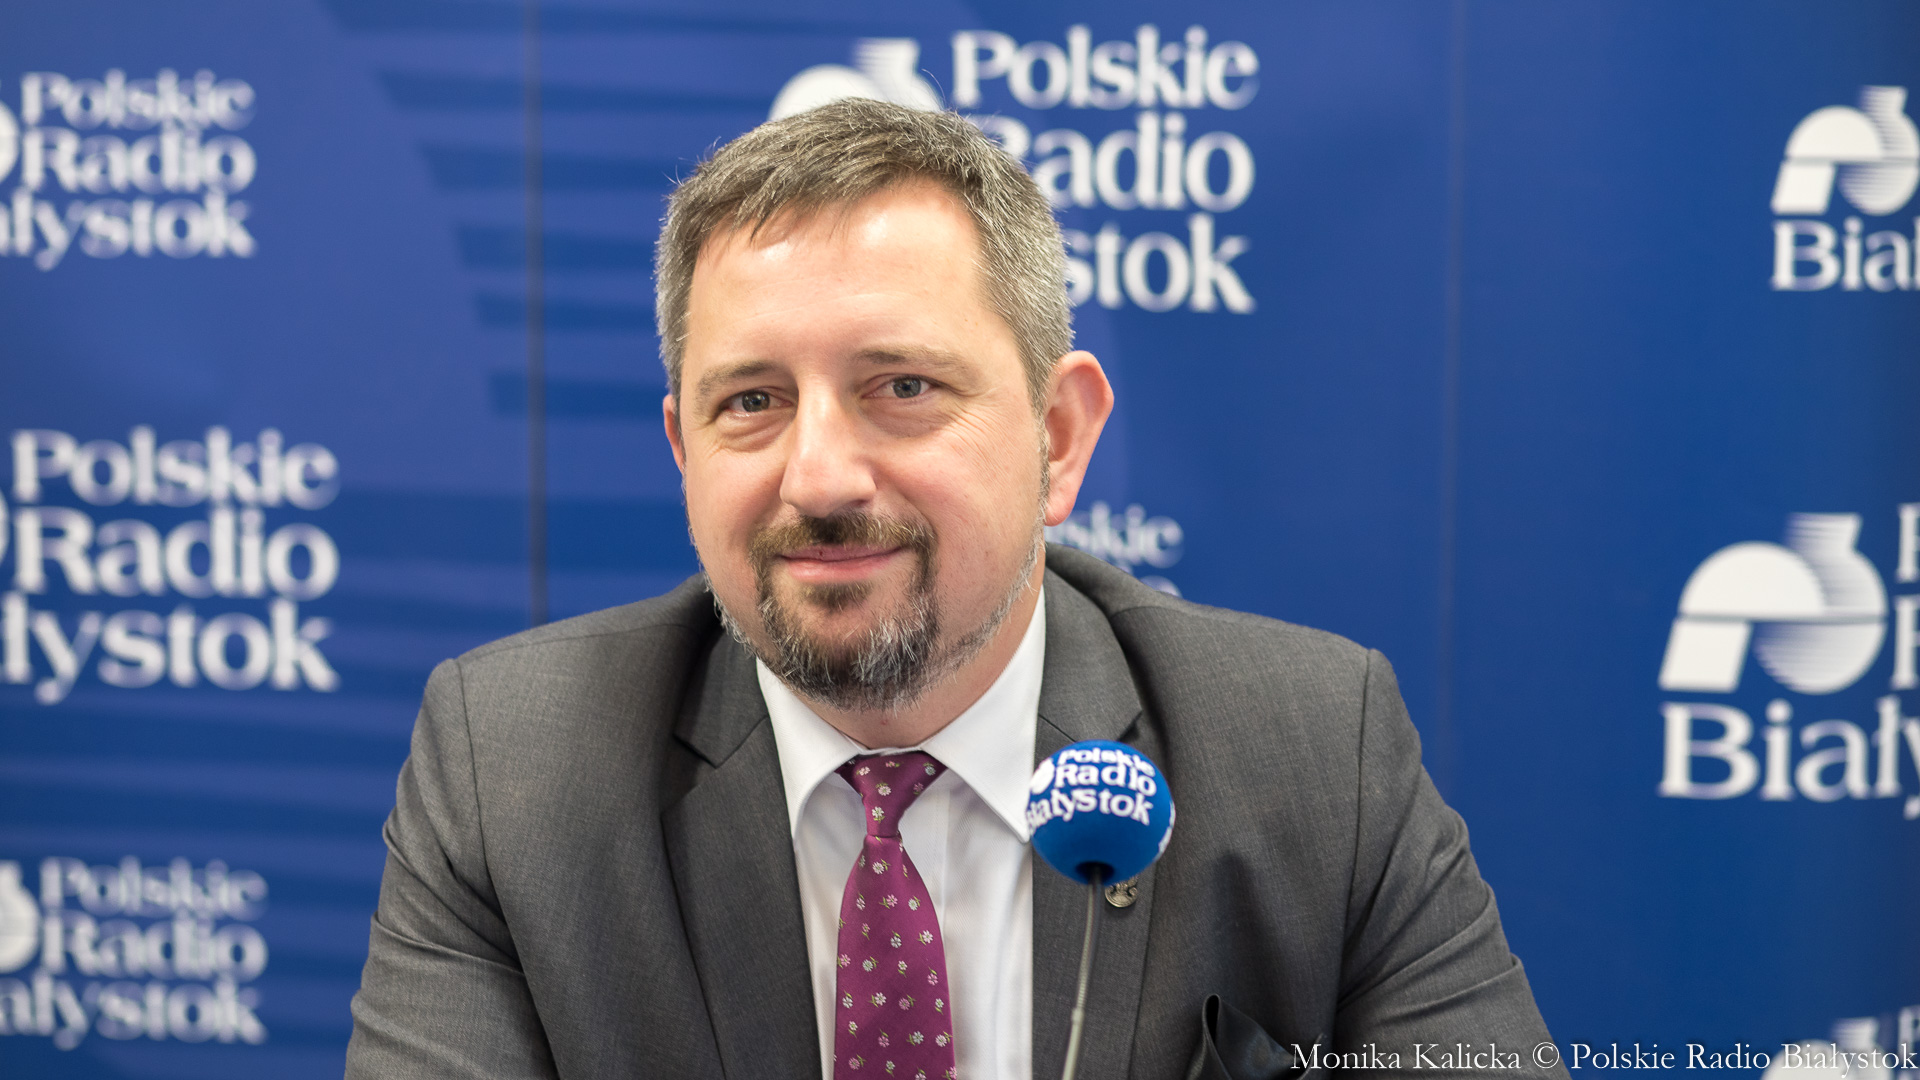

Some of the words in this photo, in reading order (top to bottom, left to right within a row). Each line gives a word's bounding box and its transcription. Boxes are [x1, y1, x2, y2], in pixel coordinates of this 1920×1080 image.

[22, 68, 256, 131] Polskie
[951, 24, 1258, 110] Polskie
[22, 124, 257, 194] Radio
[12, 424, 340, 510] Polskie
[14, 506, 340, 601] Radio
[1055, 763, 1157, 796] Radio
[40, 856, 269, 920] Polskie
[42, 908, 269, 982] Radio
